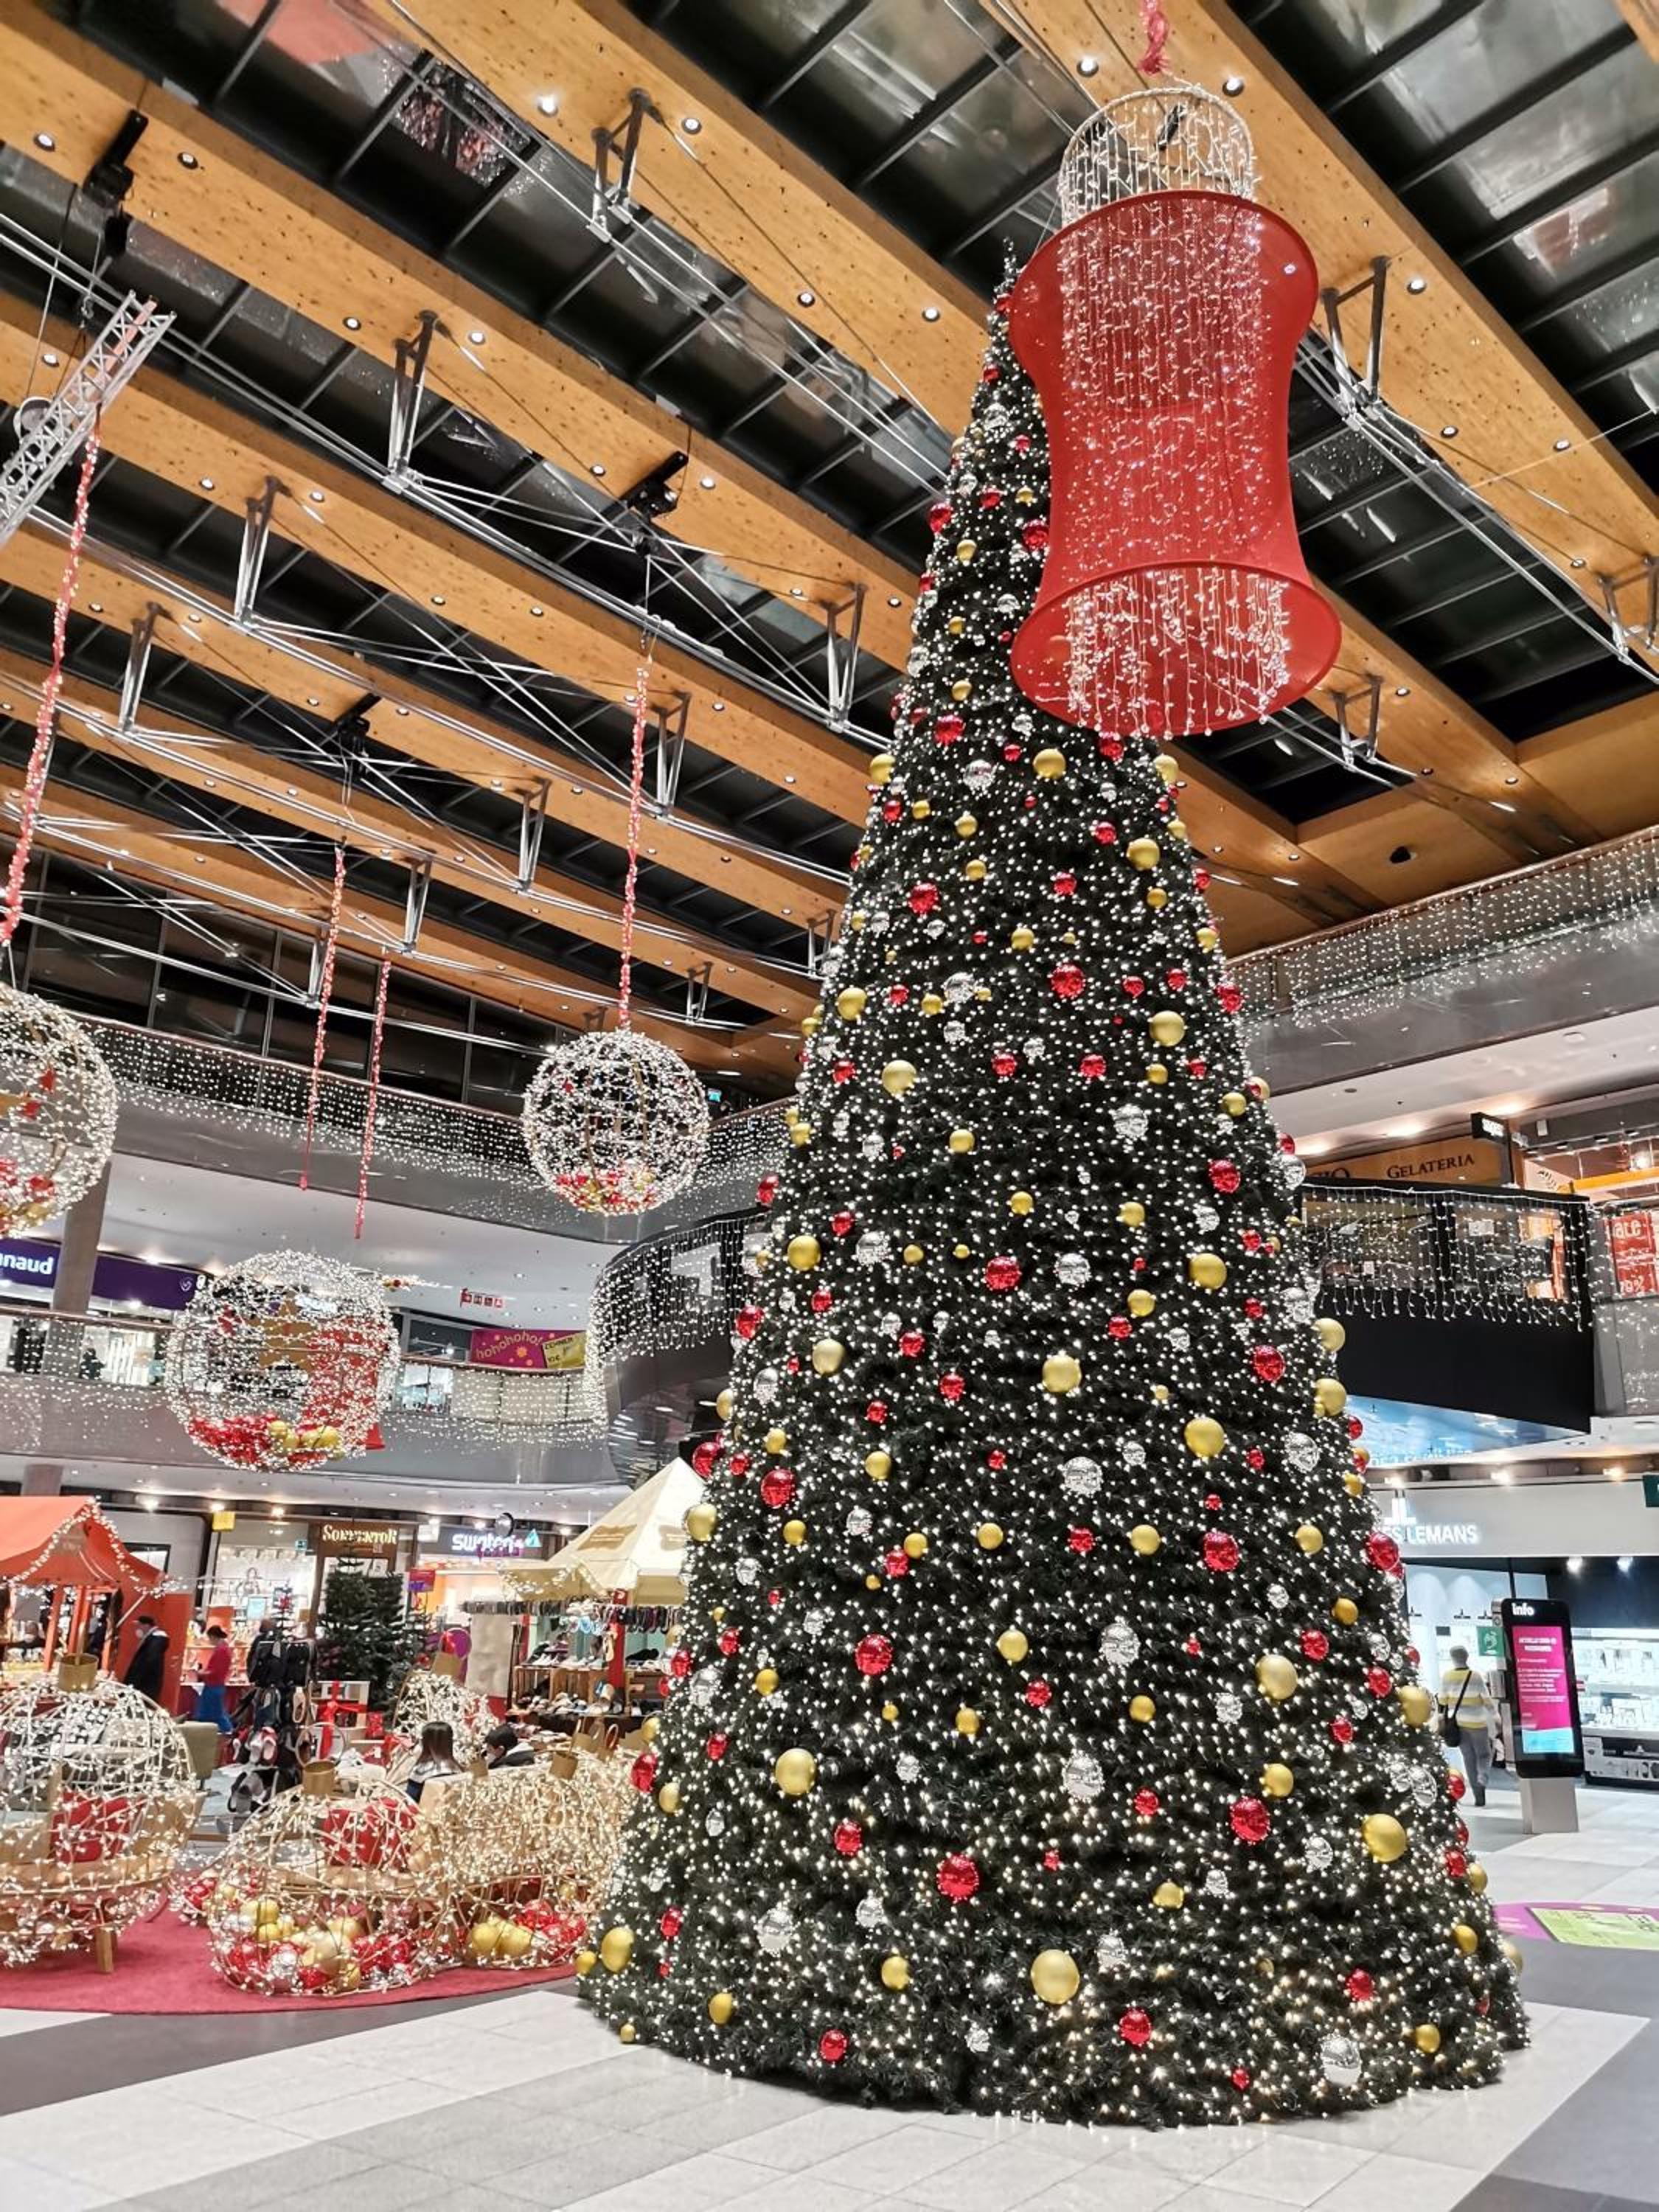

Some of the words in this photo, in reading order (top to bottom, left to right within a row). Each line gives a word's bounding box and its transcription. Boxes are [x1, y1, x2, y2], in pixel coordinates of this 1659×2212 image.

[1386, 1154, 1475, 1179] GELATERIA
[0, 1253, 54, 1275] naud
[1405, 1524, 1478, 1545] LEMANS
[1512, 1602, 1534, 1615] info
